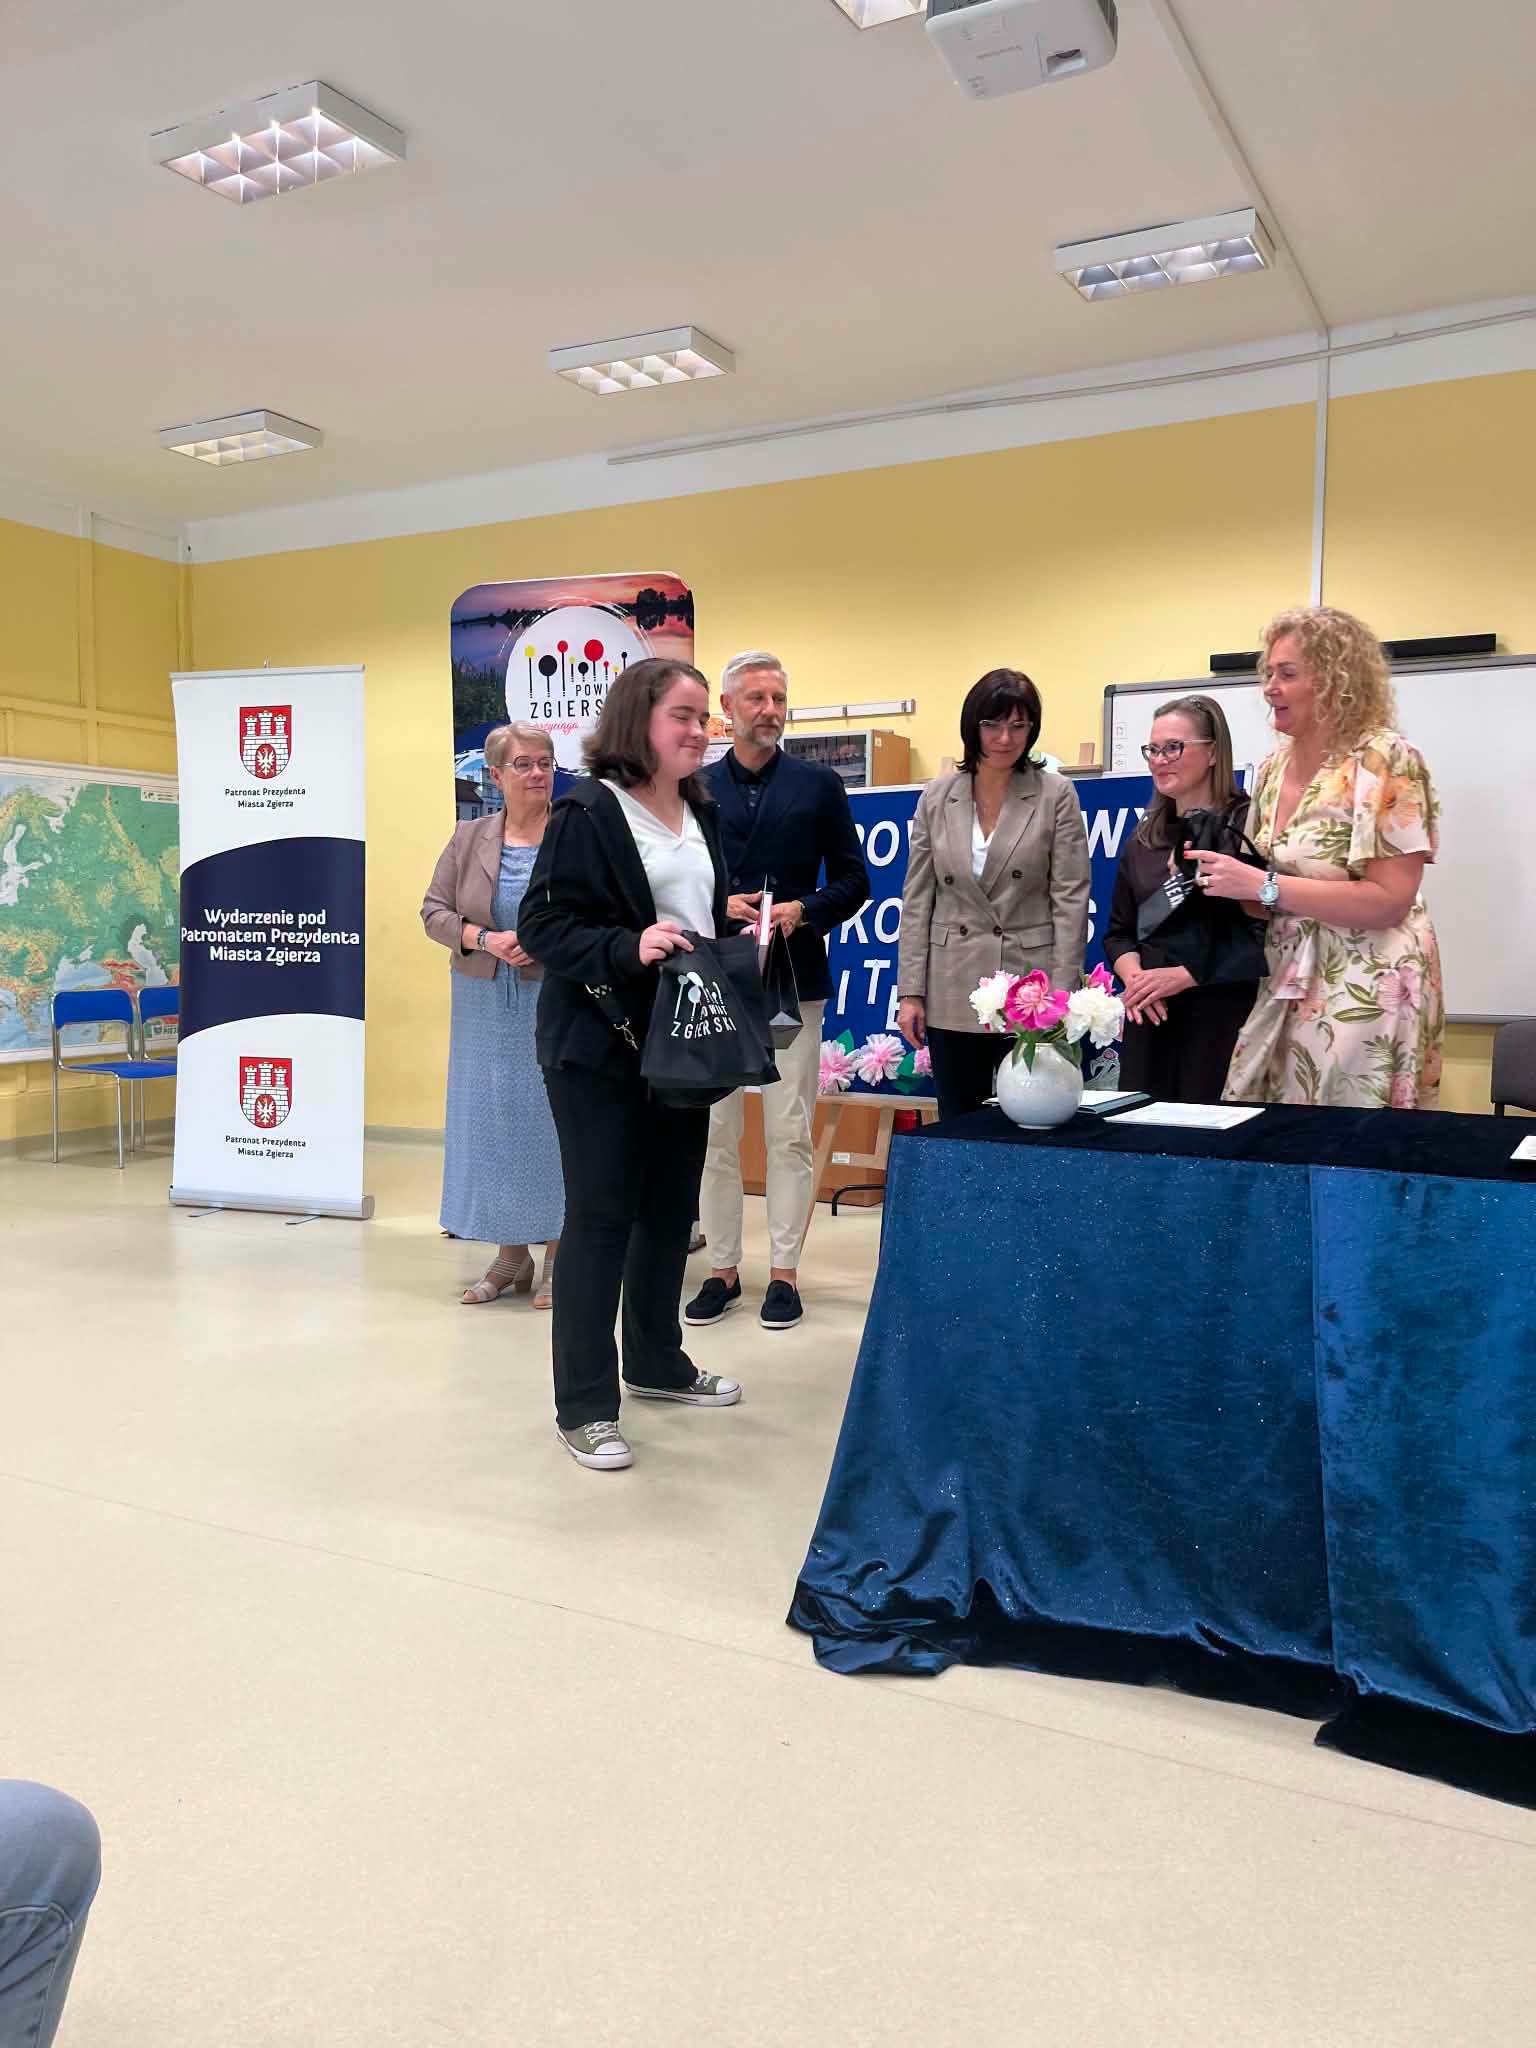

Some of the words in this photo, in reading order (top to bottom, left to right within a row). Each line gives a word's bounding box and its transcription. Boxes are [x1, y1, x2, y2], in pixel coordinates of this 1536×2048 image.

[575, 683, 609, 697] POWI
[530, 699, 604, 719] ZGIERS
[225, 788, 260, 796] Patronat
[262, 787, 306, 797] Prezydenta
[238, 800, 265, 808] Miasta
[266, 800, 294, 809] Zgierza
[204, 909, 294, 927] Wydarzenie
[298, 909, 326, 928] pod
[181, 928, 266, 943] Patronatem
[271, 928, 360, 947] Prezydenta
[210, 946, 262, 961] Miasta
[266, 947, 321, 966] Zgierza
[671, 1016, 737, 1039] ZGIERSKI
[225, 1135, 260, 1144] Patronat
[262, 1137, 306, 1147] Prezydenta
[237, 1147, 264, 1156] Miasta
[265, 1149, 294, 1159] Zgierza
